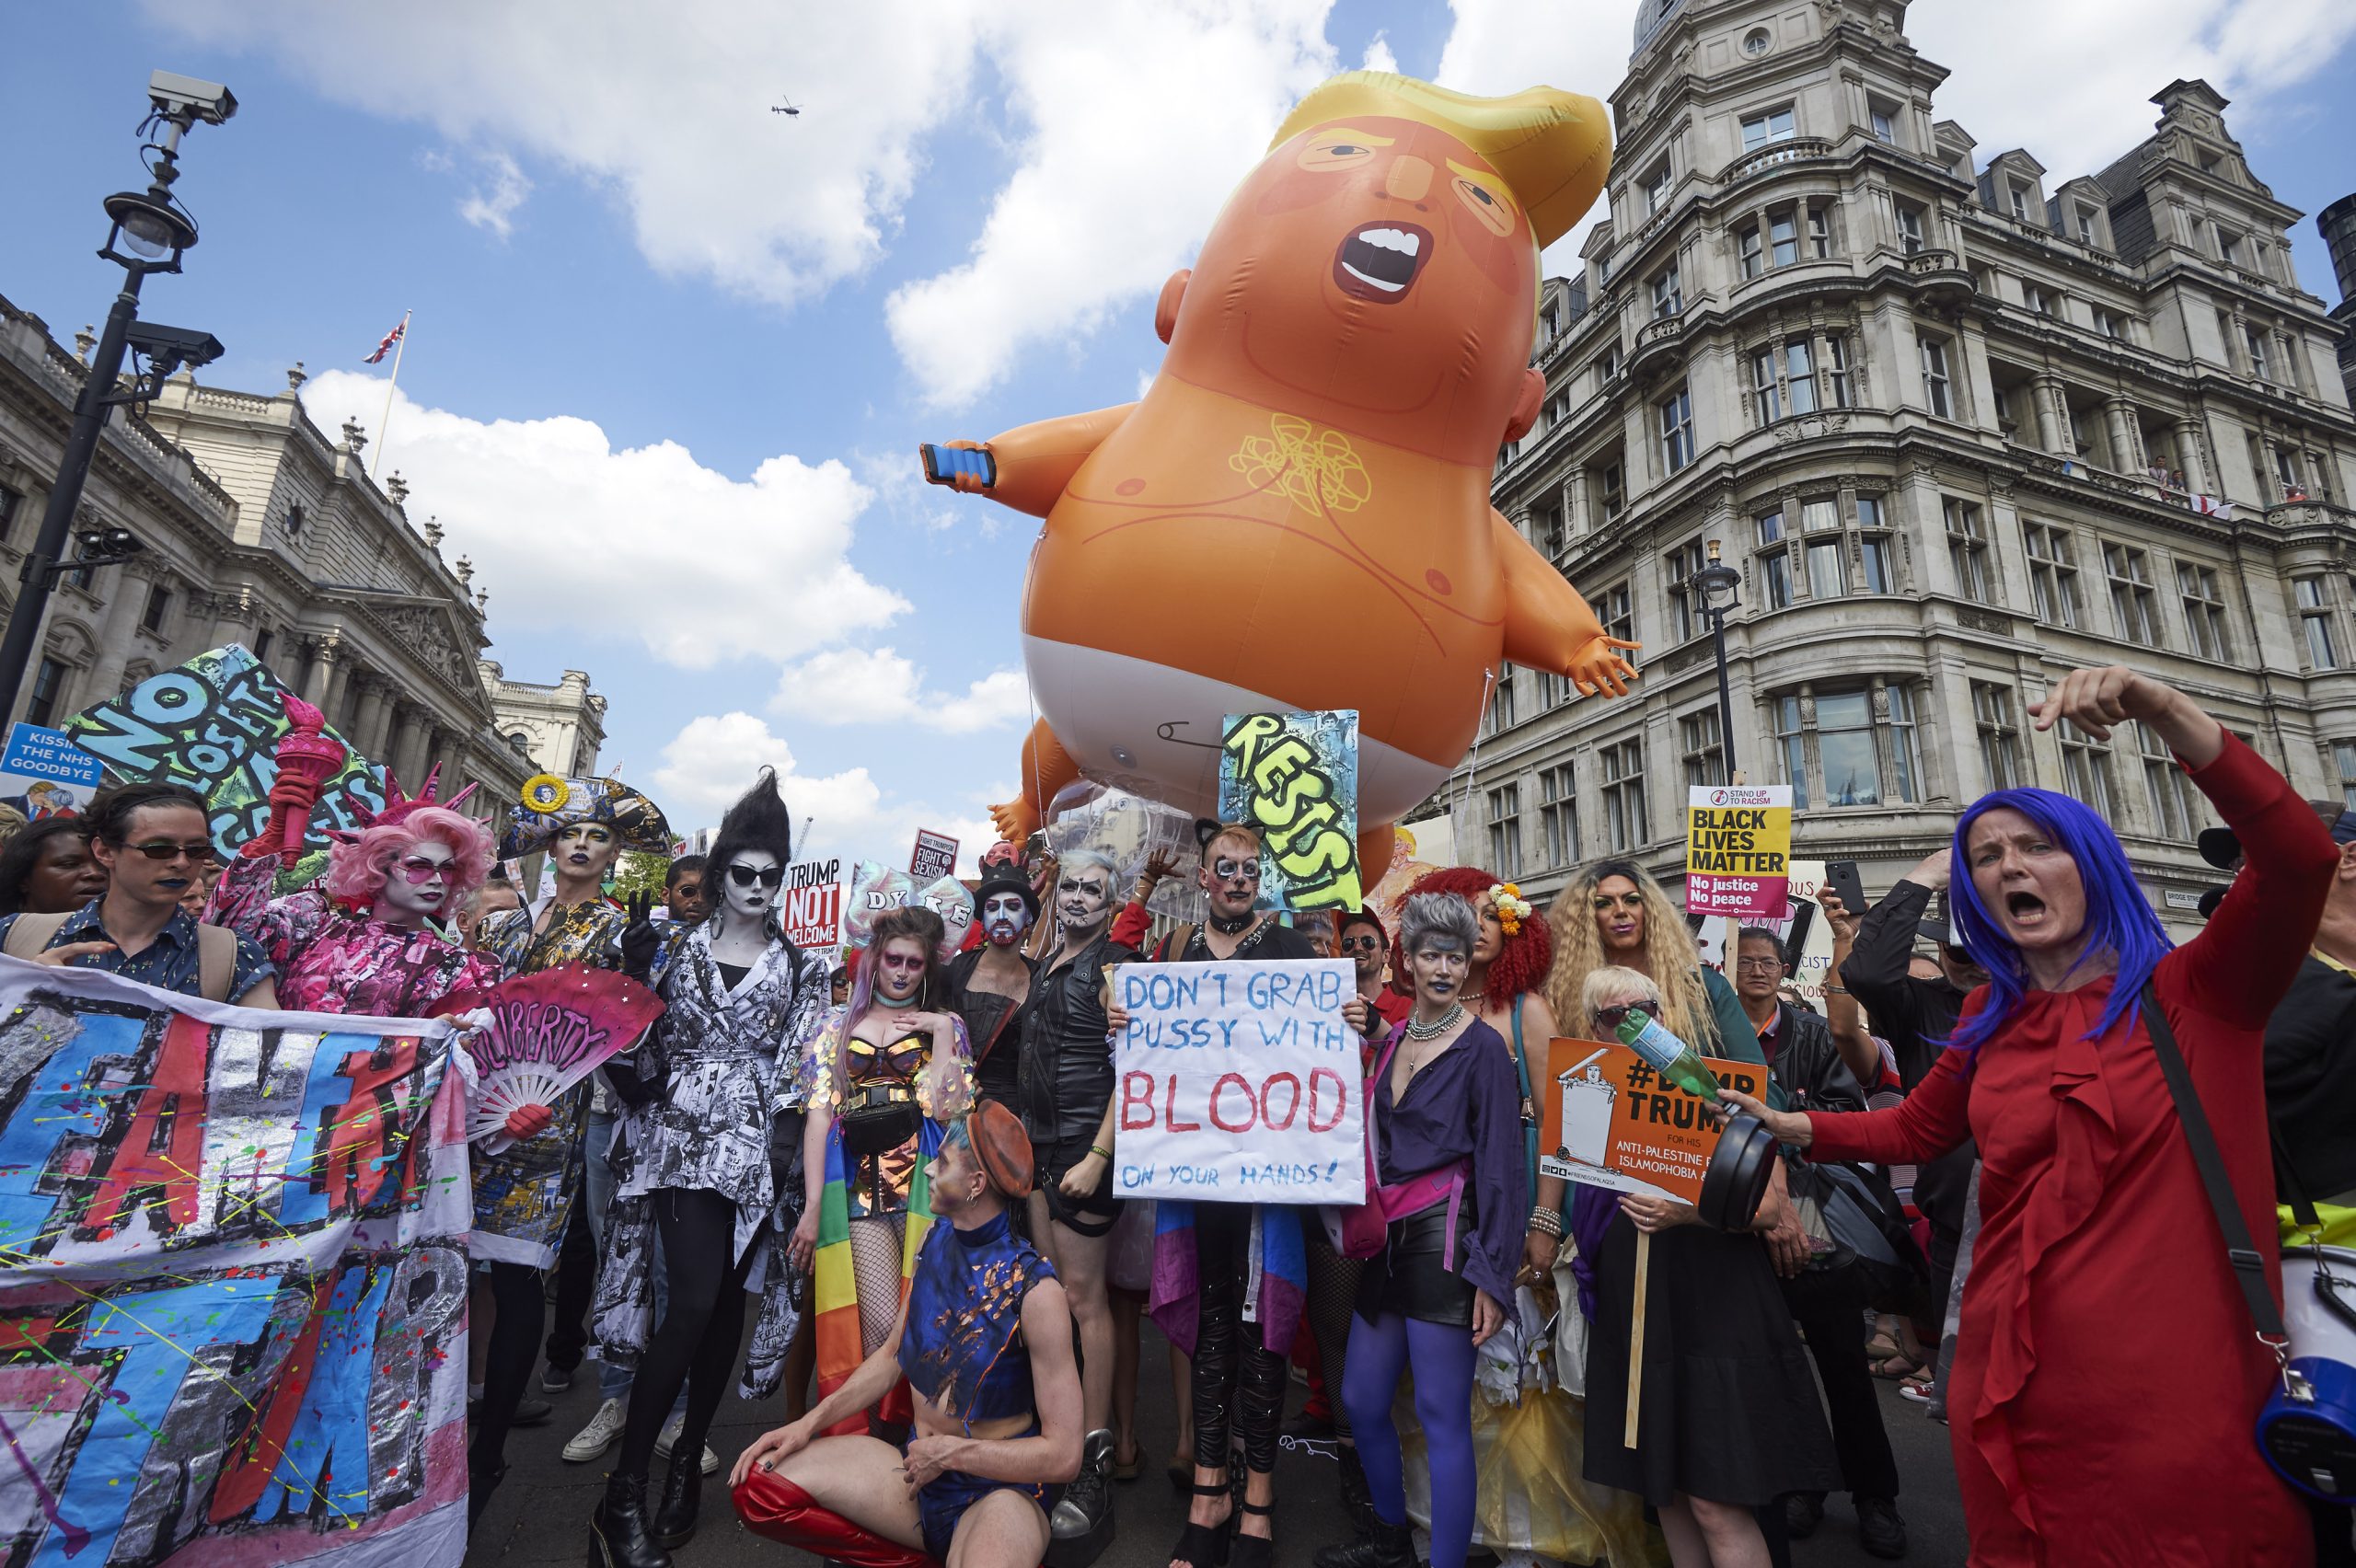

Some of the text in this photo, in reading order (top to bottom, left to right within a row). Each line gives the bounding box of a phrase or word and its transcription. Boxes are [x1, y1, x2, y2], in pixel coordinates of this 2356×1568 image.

[72, 668, 217, 776] NO
[166, 667, 287, 797] LOSETS
[29, 732, 74, 749] KISSI
[21, 744, 93, 767] THE NHS
[11, 757, 94, 779] GOODBYE
[1693, 810, 1767, 829] BLACK
[920, 836, 954, 852] FIGHT TRUMPISM
[1692, 830, 1754, 850] LIVES
[917, 847, 942, 865] FIGHT
[1692, 850, 1784, 871] MATTER
[791, 859, 839, 890] TRUMP
[914, 860, 946, 880] SEXISM
[1691, 876, 1759, 893] No justice
[788, 882, 837, 929] NOT
[1691, 889, 1752, 907] No peace
[2167, 893, 2200, 903] BRIDGE STRE
[787, 924, 836, 946] WELCOME
[1125, 969, 1342, 1012] DON'T GRAB
[1126, 1016, 1345, 1052] PUSSY WITH
[1626, 1059, 1756, 1097] #DMP
[1121, 1066, 1346, 1134] BLOOD
[1627, 1090, 1721, 1134] TRUM
[1668, 1134, 1702, 1148] FOR HIS
[1616, 1140, 1703, 1166] ANTI-PALESTINE
[1122, 1158, 1339, 1189] ON YOUR HANDS!
[1619, 1155, 1697, 1179] ISLAMOPHOBIA
[33, 1242, 468, 1568] TRUMP
